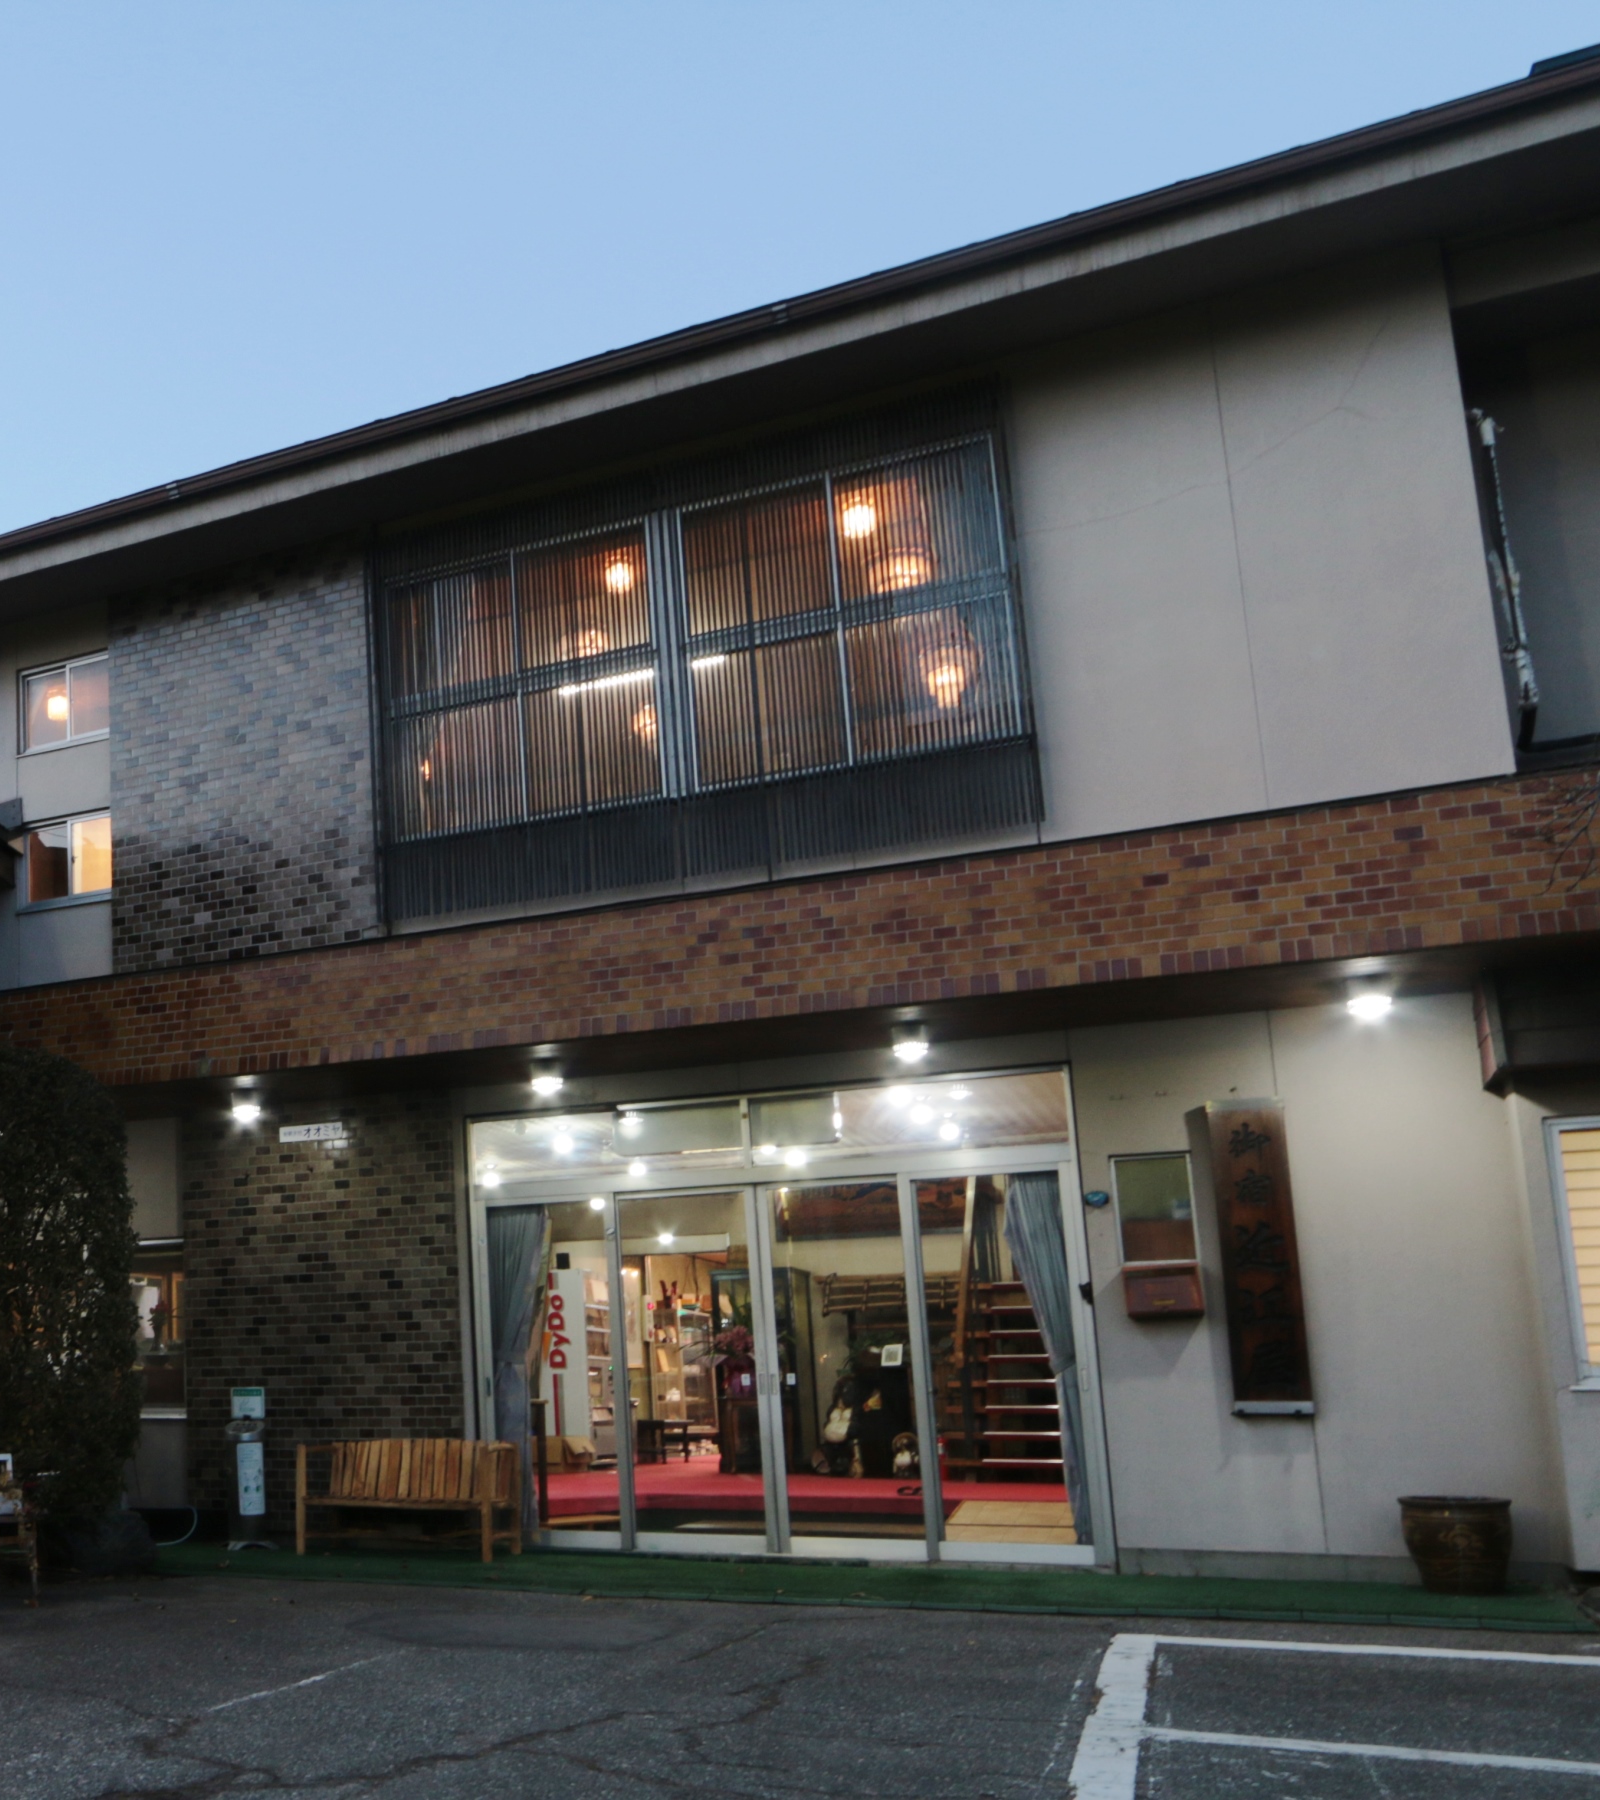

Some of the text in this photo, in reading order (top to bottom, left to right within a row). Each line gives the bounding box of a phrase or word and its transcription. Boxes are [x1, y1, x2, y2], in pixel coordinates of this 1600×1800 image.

[303, 1125, 341, 1139] オオミヤ
[547, 1294, 571, 1369] DyDo
